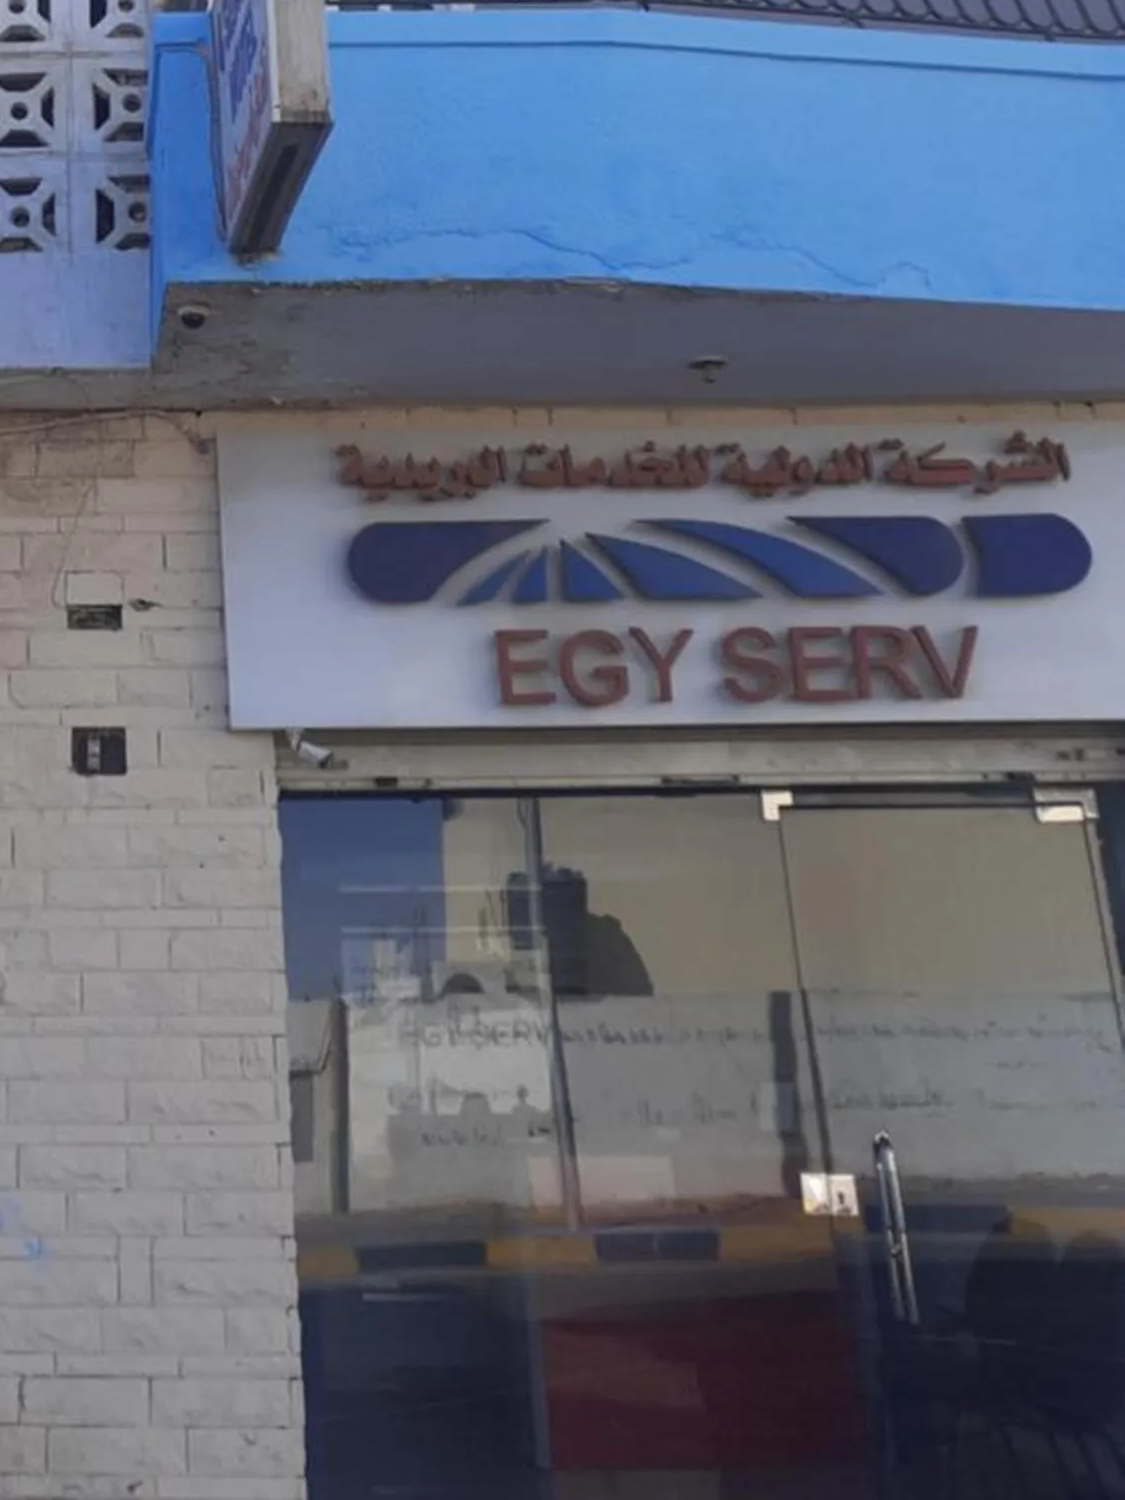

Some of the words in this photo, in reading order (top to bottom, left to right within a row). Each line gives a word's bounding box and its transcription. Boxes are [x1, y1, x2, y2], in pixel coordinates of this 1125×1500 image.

[335, 443, 507, 503] البريدية
[514, 440, 711, 489] للخدمات
[713, 442, 874, 499] الدولية
[876, 430, 1071, 496] الشركة
[493, 626, 694, 707] EGY
[718, 625, 979, 703] SERV
